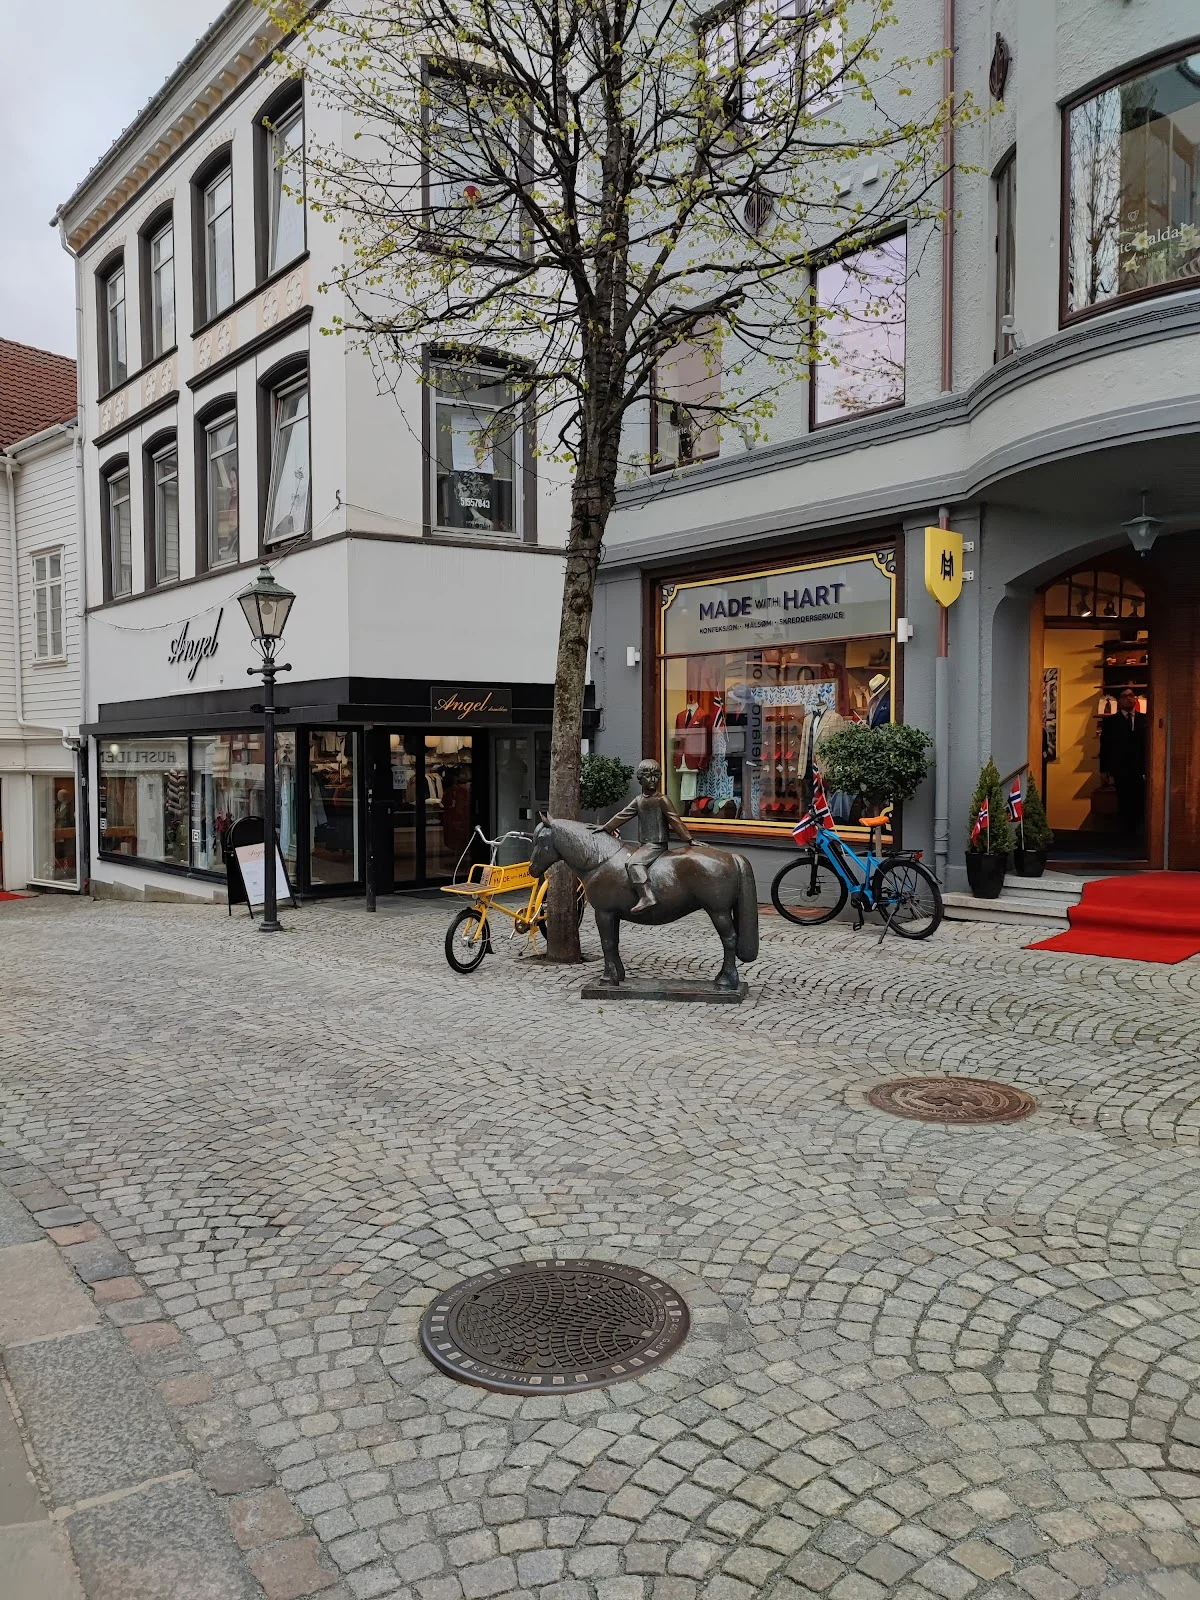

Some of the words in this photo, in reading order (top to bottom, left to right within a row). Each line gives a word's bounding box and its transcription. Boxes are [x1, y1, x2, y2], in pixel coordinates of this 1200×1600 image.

[699, 596, 752, 621] MADE
[754, 597, 781, 609] WITH
[783, 582, 845, 610] HART
[168, 607, 223, 682] Angel
[699, 624, 739, 635] KONFEKSJON
[434, 691, 493, 720] Angel
